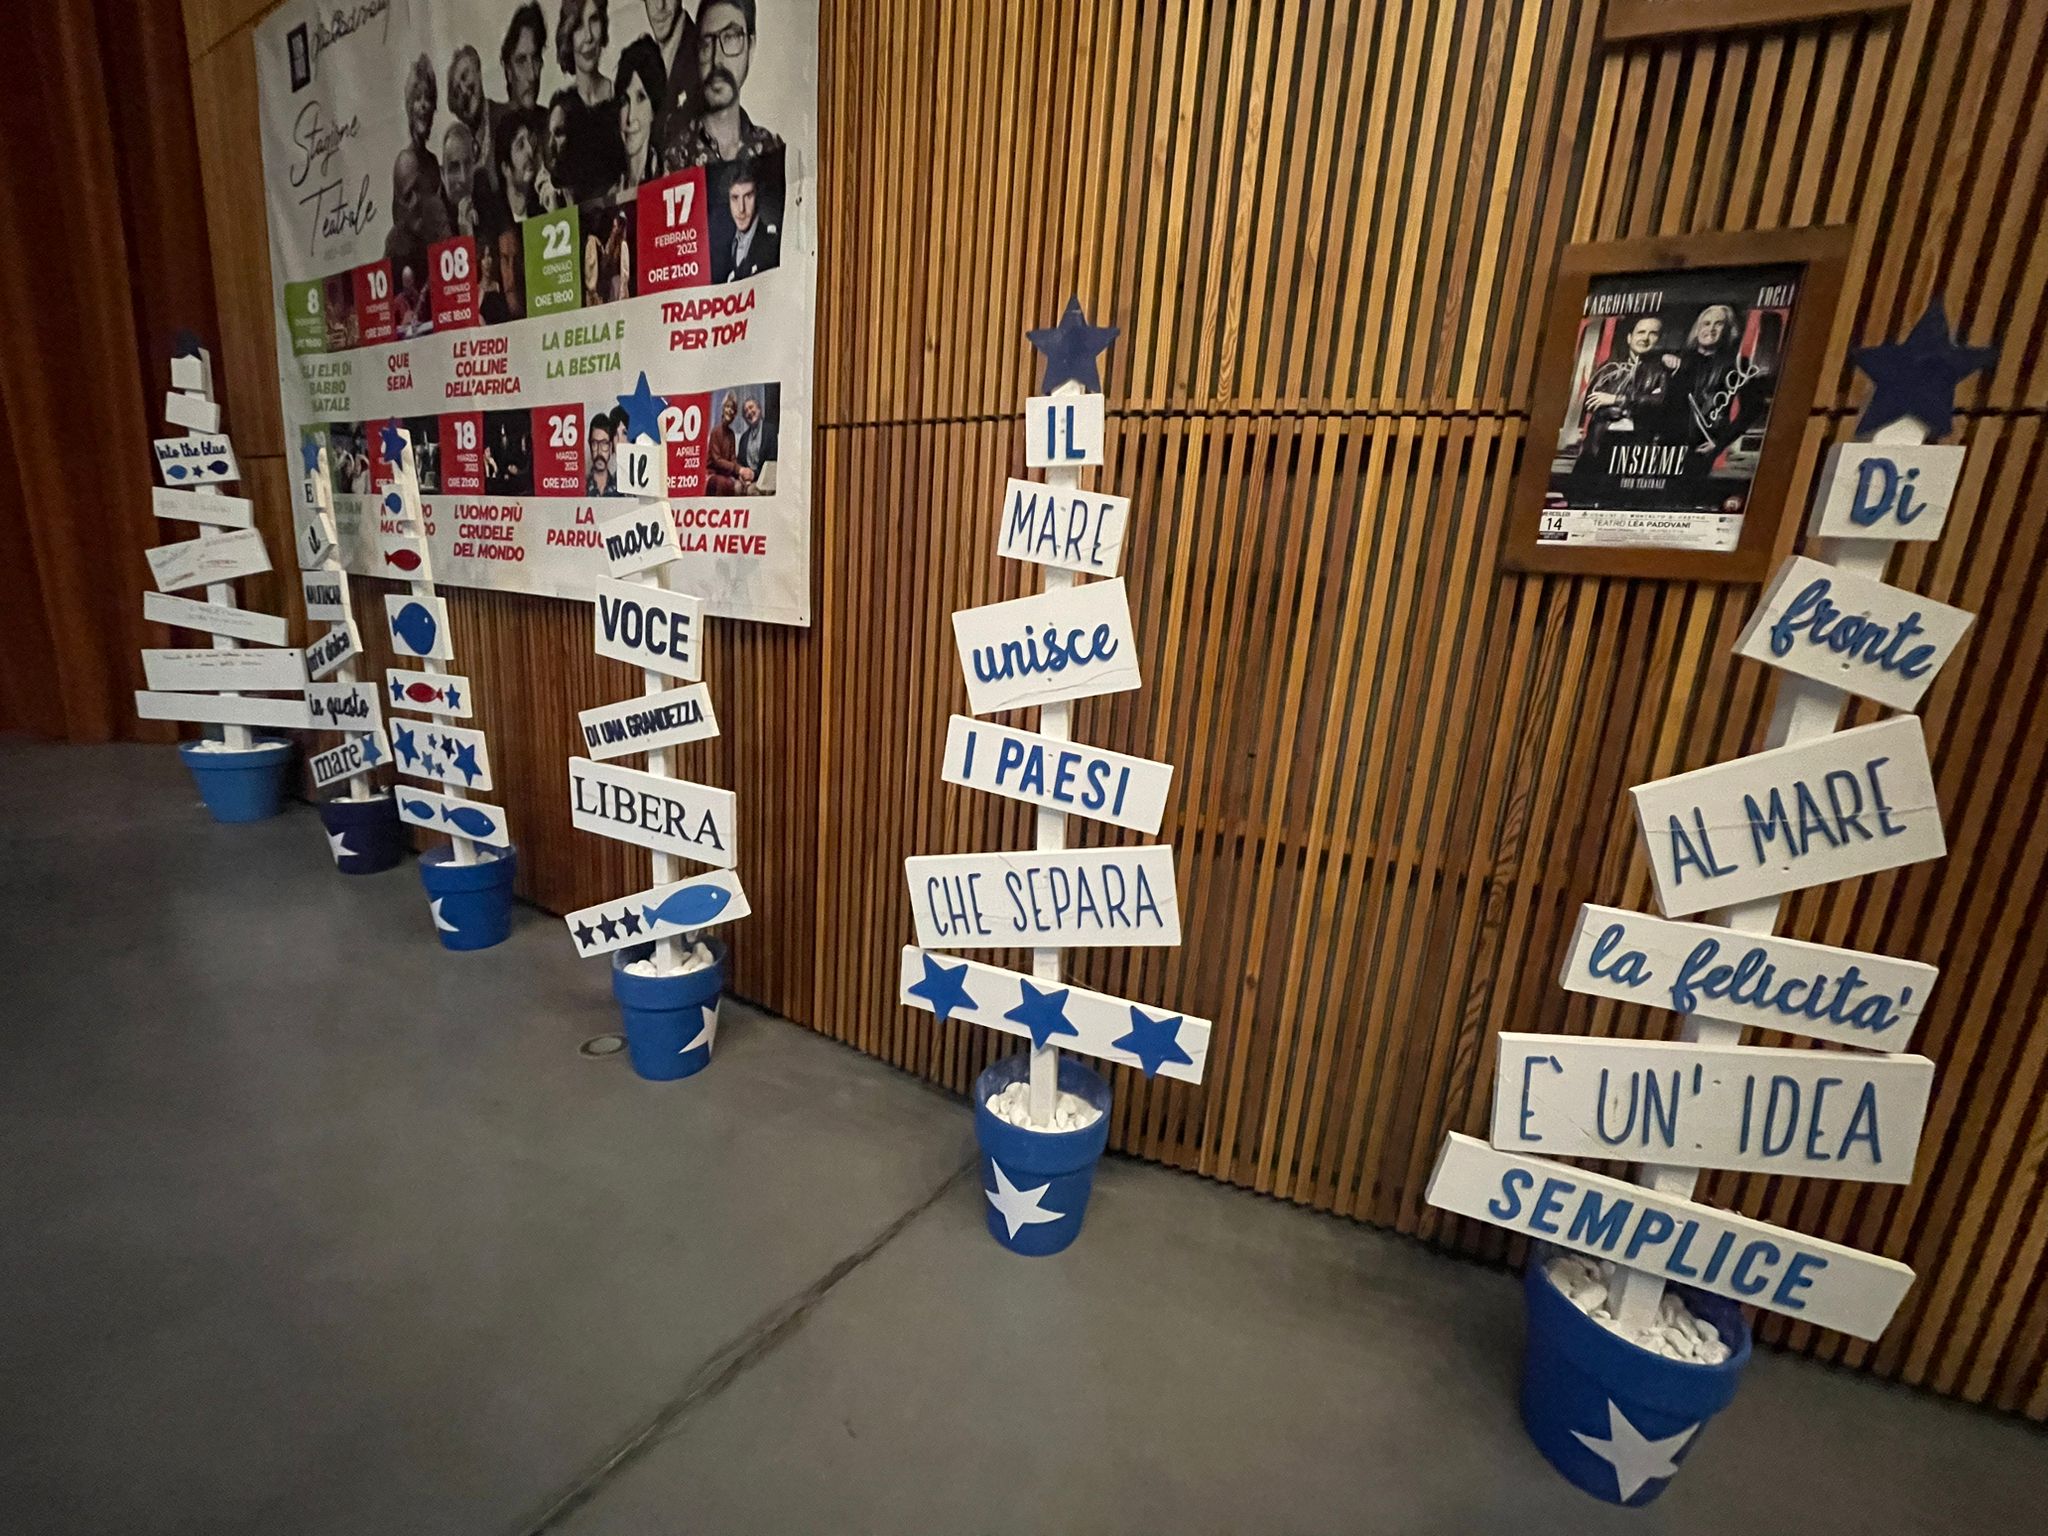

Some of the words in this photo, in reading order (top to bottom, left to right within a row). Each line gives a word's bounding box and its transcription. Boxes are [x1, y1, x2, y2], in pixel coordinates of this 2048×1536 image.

[299, 173, 377, 256] Teatrale
[662, 182, 695, 228] 17
[542, 220, 572, 260] 22
[655, 229, 697, 247] FEBBRAIO
[677, 242, 697, 256] 2023
[440, 247, 469, 281] 08
[648, 270, 669, 283] ORE
[671, 262, 699, 280] 21:00
[367, 270, 388, 300] 10
[535, 295, 552, 307] ORE
[661, 289, 755, 324] TRAPPOLA
[453, 342, 467, 358] LE
[469, 337, 508, 356] VERDI
[542, 331, 560, 351] LA
[564, 322, 611, 348] BELLA
[615, 319, 625, 340] E
[670, 330, 707, 351] PER
[711, 319, 748, 348] TOPI
[388, 353, 409, 371] QUE
[456, 358, 508, 377] COLLINE
[547, 360, 565, 379] LA
[569, 351, 621, 376] BESTIA
[387, 370, 413, 391] SERÀ
[445, 377, 521, 398] DELL'AFRICA
[454, 421, 476, 450] 18
[548, 414, 578, 448] 26
[666, 405, 702, 442] 20
[1048, 405, 1086, 459] IL
[180, 442, 201, 457] the
[201, 441, 227, 456] blue
[556, 451, 578, 461] MARZO
[676, 446, 700, 457] APRILE
[1608, 445, 1689, 475] INSIEME
[304, 483, 314, 503] E
[543, 478, 560, 488] ORE
[677, 476, 699, 488] 21:00
[1851, 456, 1925, 527] Di
[455, 504, 498, 520] L'UOMO
[501, 502, 522, 522] PIÙ
[576, 507, 595, 525] LA
[672, 509, 750, 529] LOCCATI
[1546, 517, 1563, 531] 14
[1593, 519, 1626, 527] TEATRO
[1627, 520, 1645, 528] LEA
[1646, 521, 1691, 529] PADOVANI
[459, 524, 513, 541] CRUDELE
[606, 521, 664, 562] mare
[1008, 490, 1114, 566] MARE
[454, 543, 475, 557] DEL
[477, 546, 525, 561] MONDO
[713, 535, 767, 555] NEVE
[599, 594, 690, 662] VOCE
[1770, 577, 1937, 680] fronte
[972, 622, 1118, 683] unisce
[585, 723, 602, 748] DI
[601, 718, 629, 745] UNA
[626, 699, 704, 738] GRANDEZZA
[313, 743, 363, 784] mare
[962, 732, 977, 779] I
[996, 737, 1131, 817] PAESI
[573, 775, 725, 851] LIBERA
[1669, 806, 1738, 885] AL
[1744, 756, 1907, 867] MARE
[928, 873, 991, 937] CHE
[1005, 863, 1163, 933] SEPARA
[1588, 923, 1653, 988] la
[1670, 939, 1914, 1033] felicita'
[1599, 1063, 1704, 1147] UN'
[1740, 1074, 1883, 1164] IDEA
[1487, 1167, 1829, 1313] SEMPLICE
